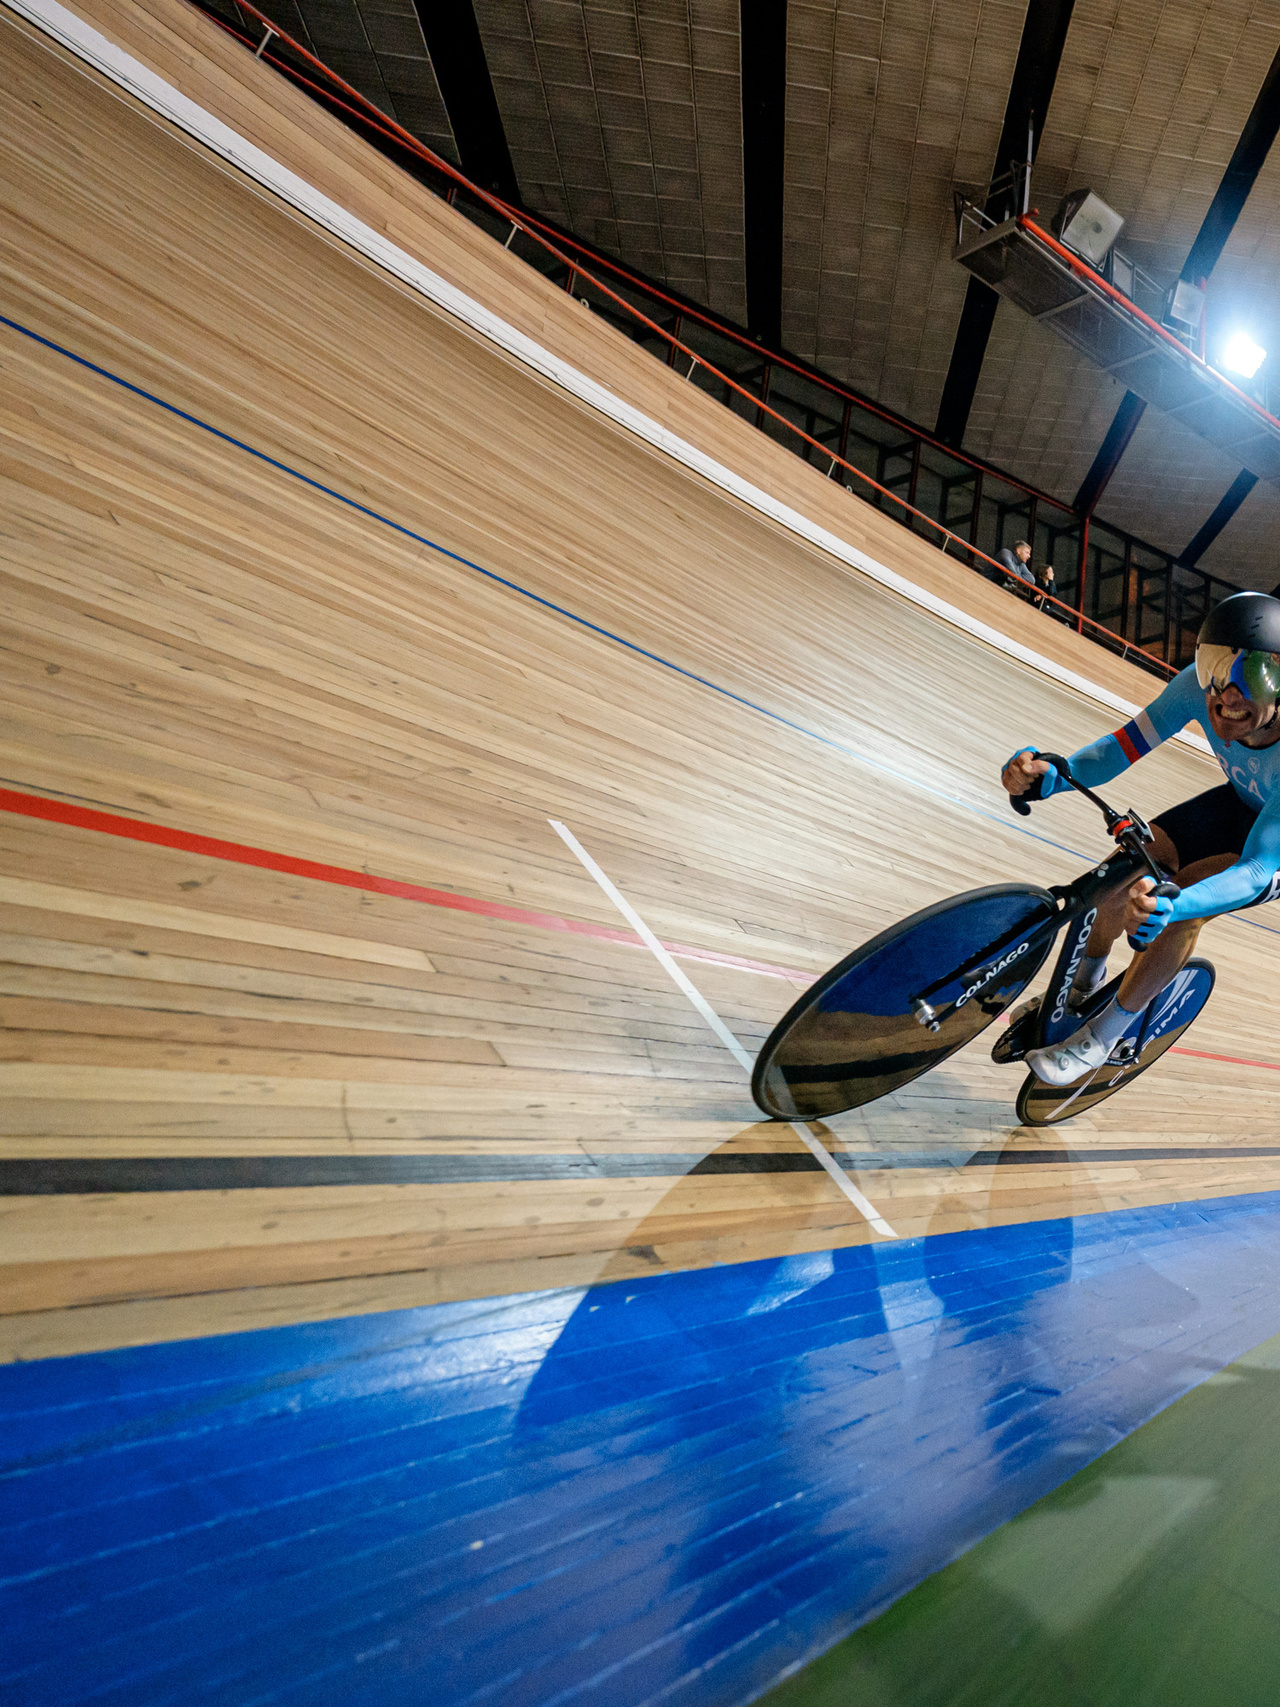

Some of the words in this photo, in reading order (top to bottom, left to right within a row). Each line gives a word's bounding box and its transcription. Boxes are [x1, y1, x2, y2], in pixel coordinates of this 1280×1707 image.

[1216, 752, 1267, 803] RCA
[955, 942, 1030, 1008] COLNAGO
[1050, 907, 1097, 1023] COLNAGO
[1109, 988, 1196, 1087] CRIMA
